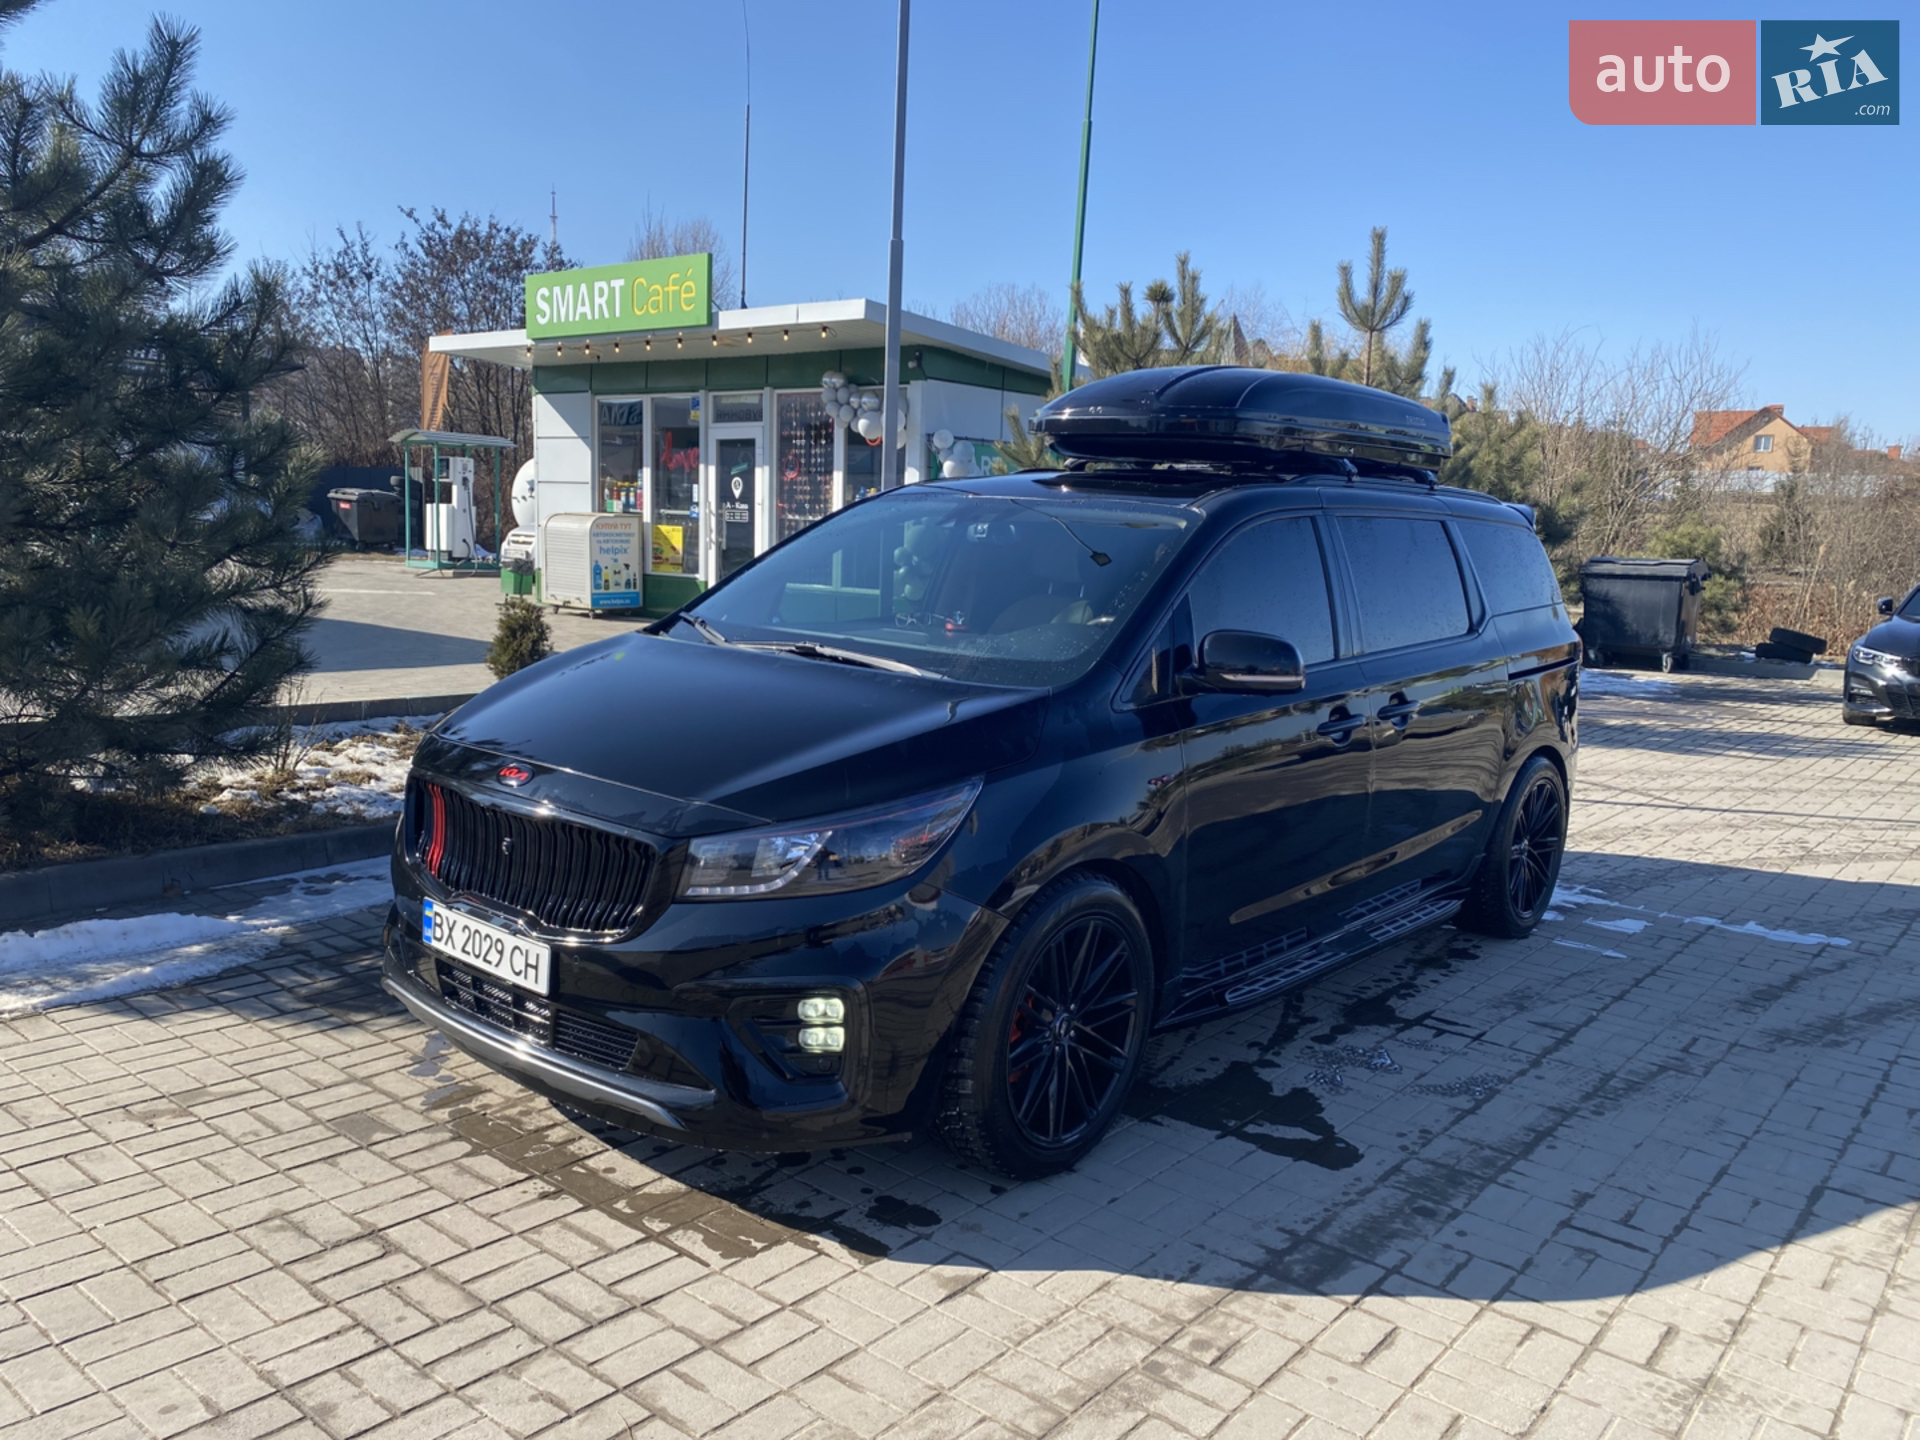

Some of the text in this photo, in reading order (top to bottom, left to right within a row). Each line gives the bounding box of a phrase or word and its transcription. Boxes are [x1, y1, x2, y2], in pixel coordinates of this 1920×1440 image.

[535, 267, 697, 325] SMART Café
[429, 372, 440, 431] ontinental
[599, 544, 629, 556] helpix
[433, 911, 540, 985] BX 2029 CH
